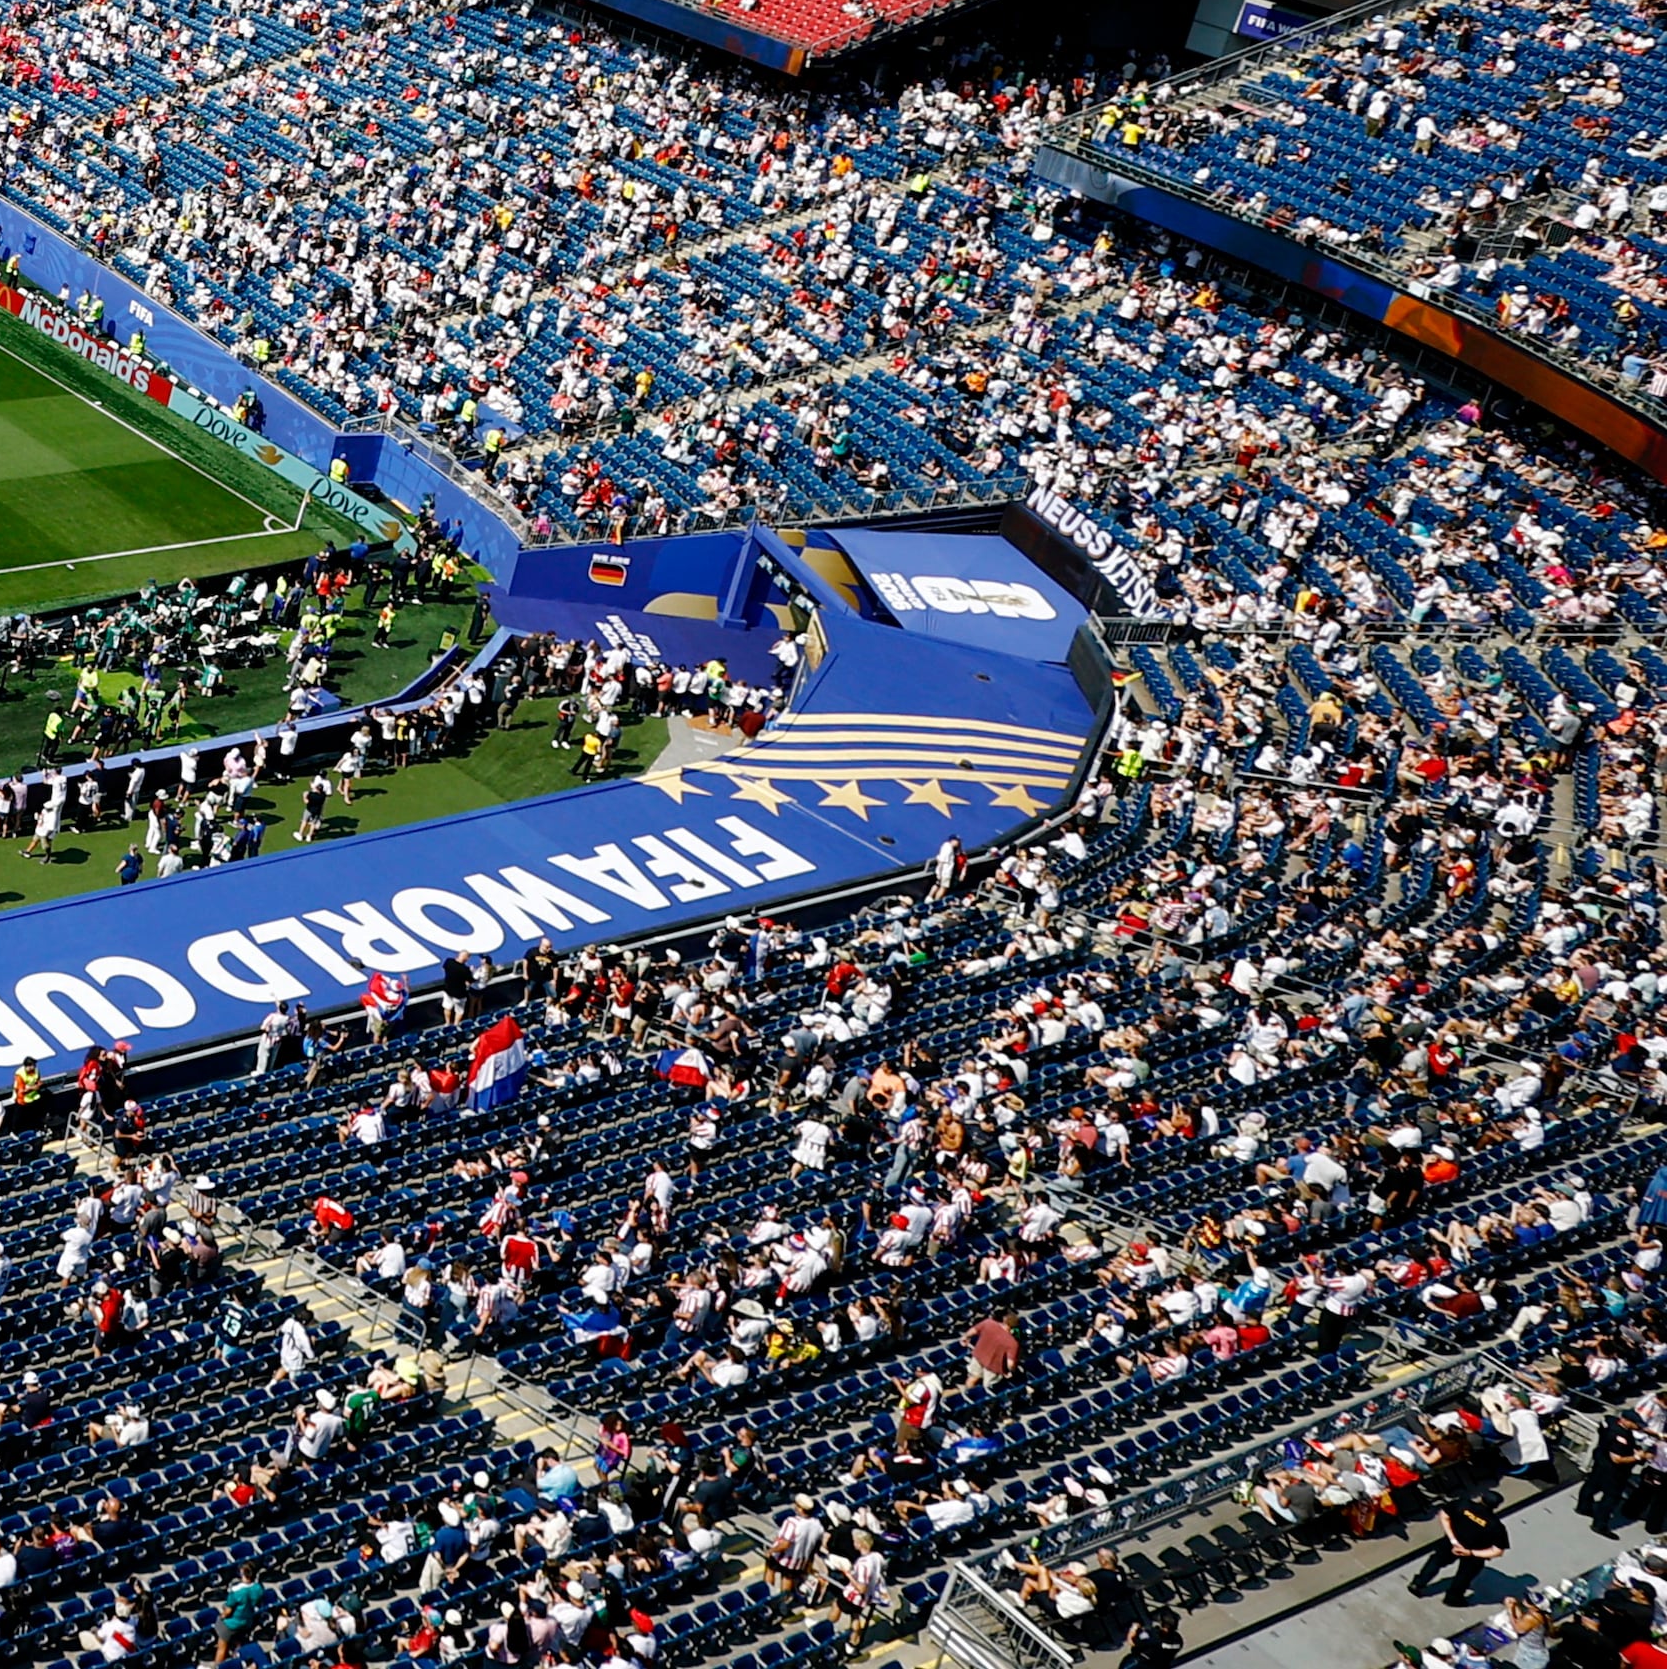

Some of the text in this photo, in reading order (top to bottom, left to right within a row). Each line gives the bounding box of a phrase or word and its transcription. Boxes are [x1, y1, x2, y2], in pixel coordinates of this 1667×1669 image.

[18, 297, 151, 394] McDonald's
[128, 299, 154, 328] FIFA
[192, 406, 248, 449] Dove
[309, 471, 370, 525] Dove
[1026, 486, 1113, 559] NEUSS
[547, 815, 817, 911] FIFA
[187, 864, 611, 1003] WORLD
